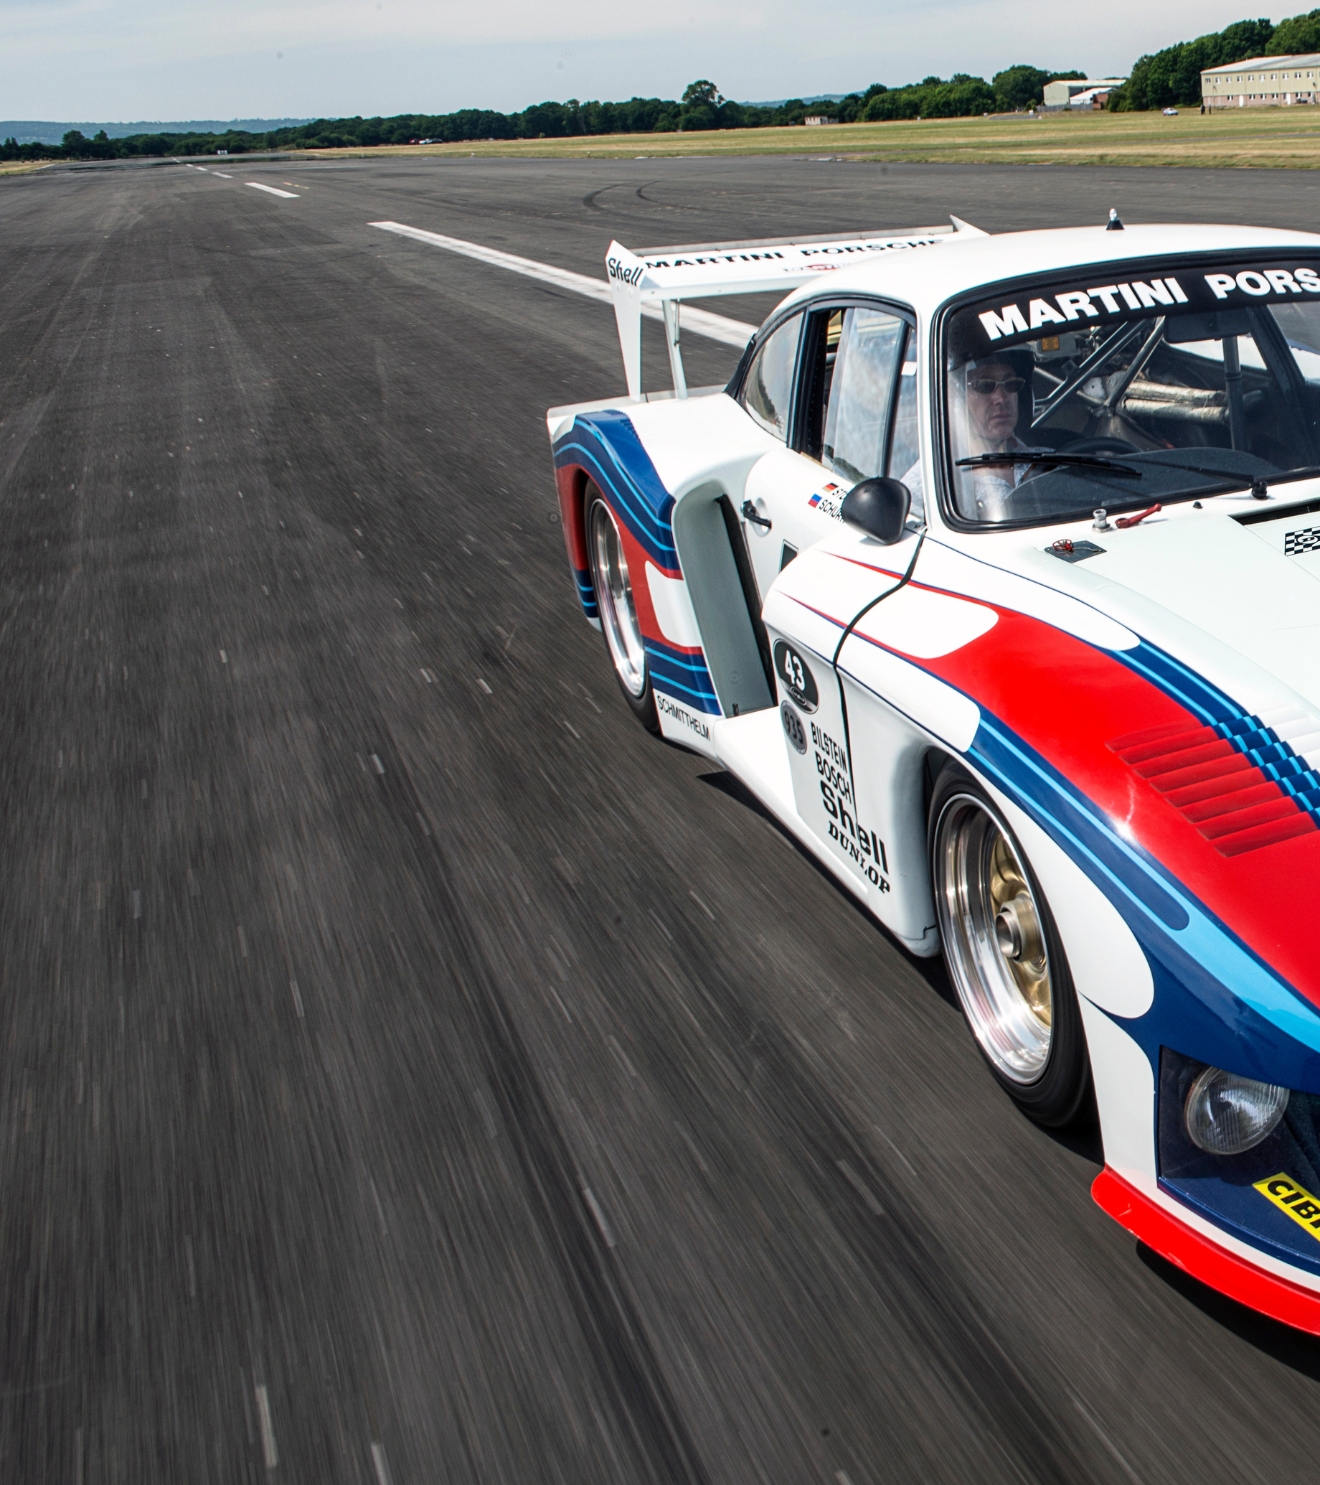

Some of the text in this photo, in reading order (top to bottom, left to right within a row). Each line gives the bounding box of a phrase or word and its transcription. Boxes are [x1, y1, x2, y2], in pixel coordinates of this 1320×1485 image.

[608, 257, 643, 287] Shell
[645, 252, 785, 268] MARTINI
[978, 277, 1189, 341] MARTINI
[784, 649, 806, 691] 43
[657, 695, 711, 741] SCHMITTHELM
[784, 710, 803, 745] 935
[810, 721, 848, 774] BILSTEIN
[815, 750, 852, 804] BOSCH
[820, 779, 890, 875] Shell
